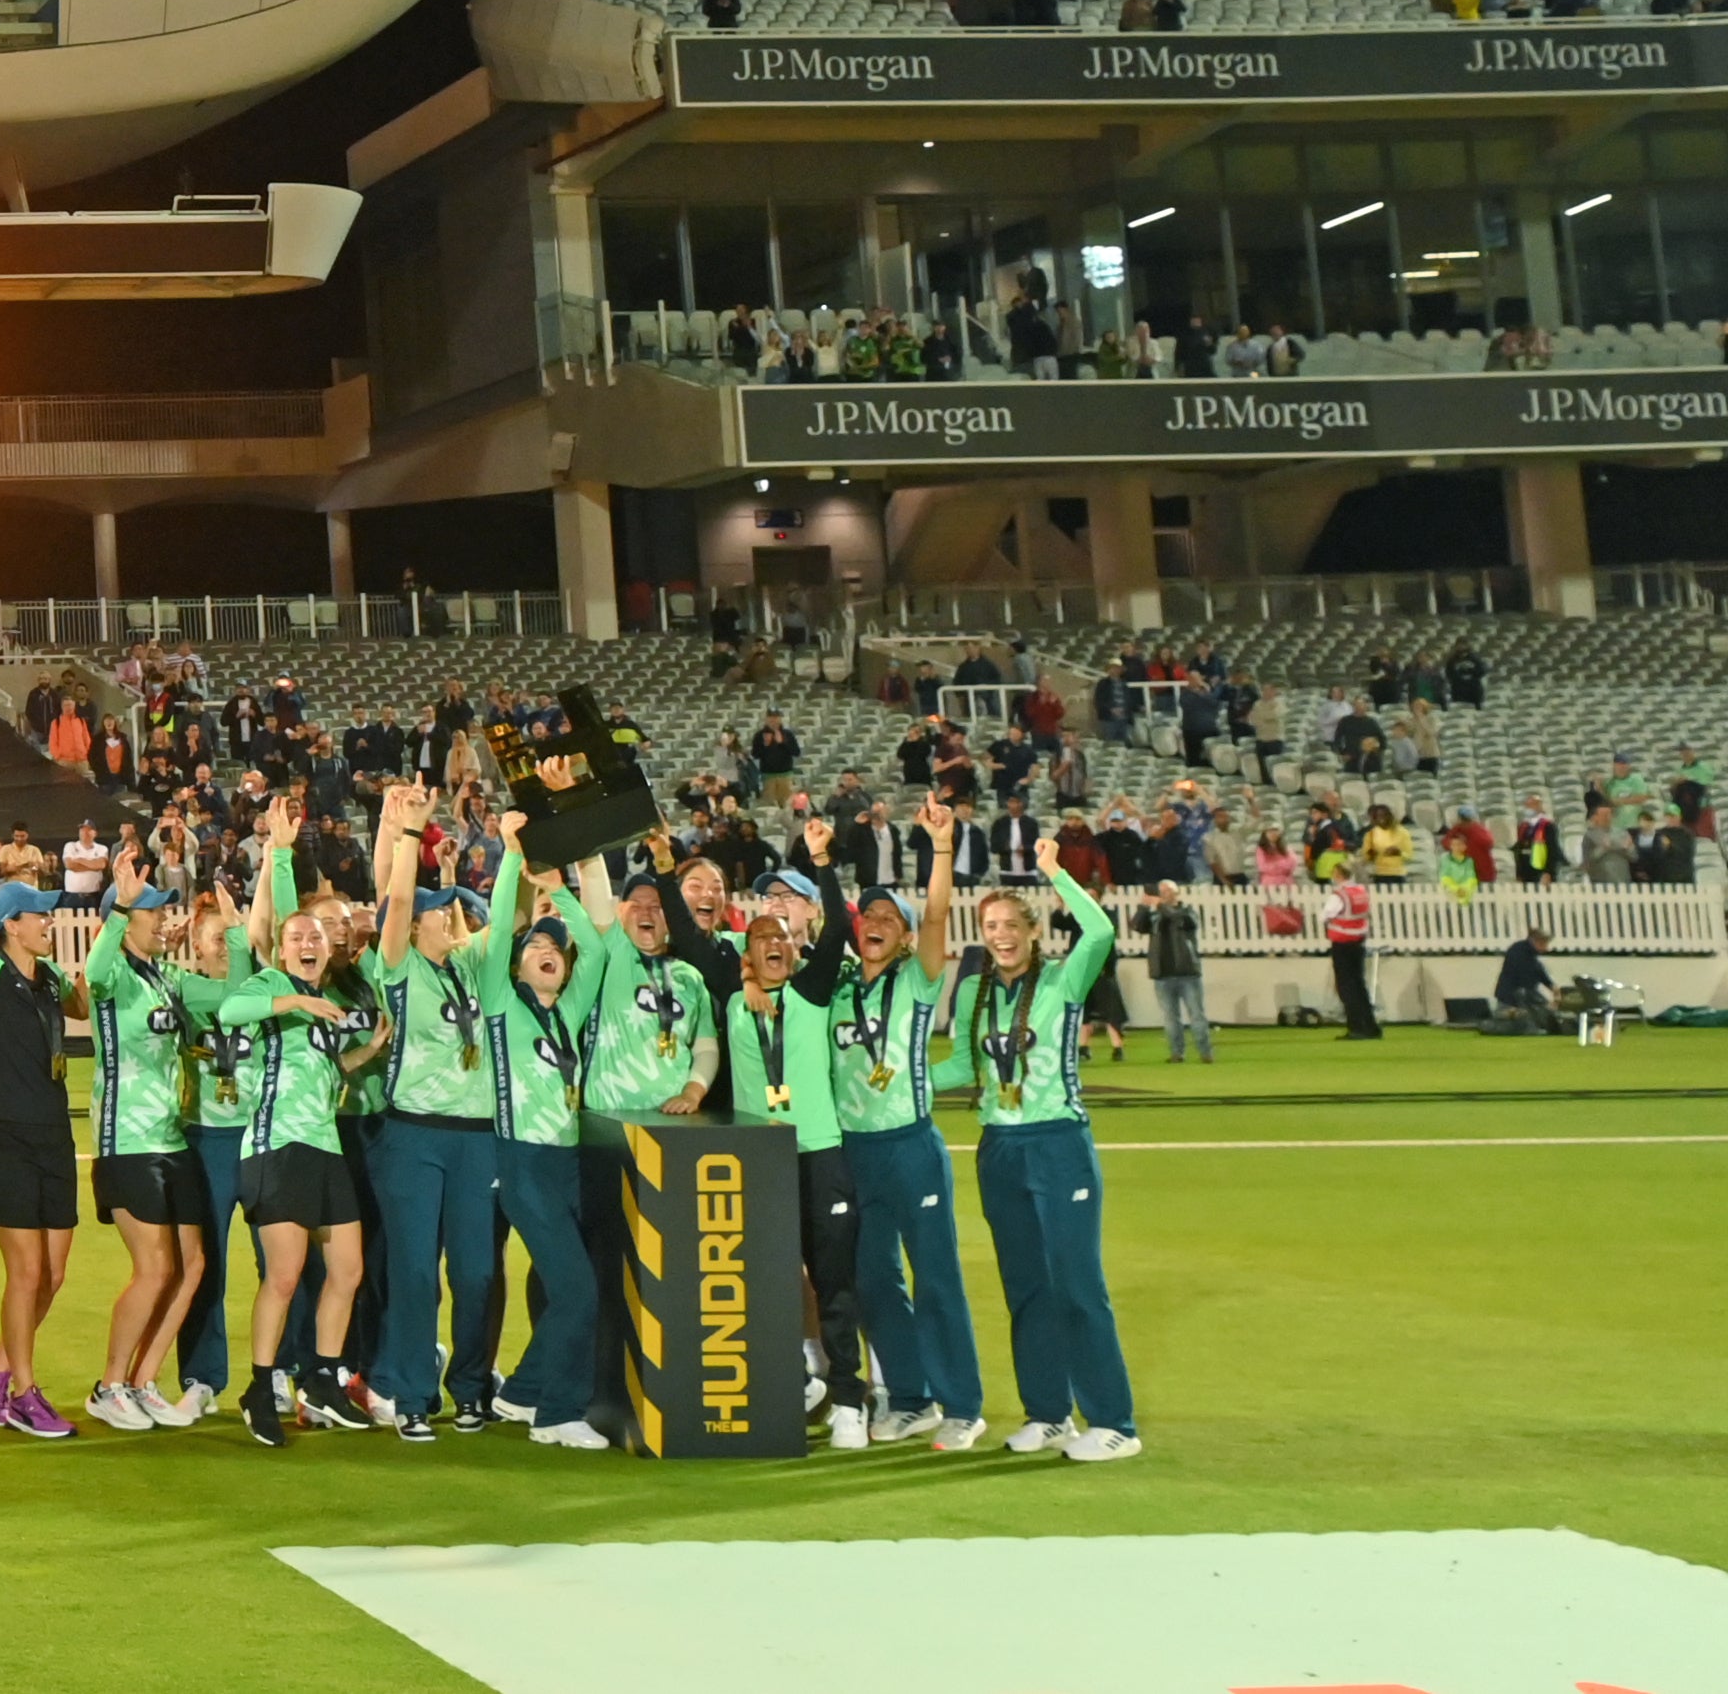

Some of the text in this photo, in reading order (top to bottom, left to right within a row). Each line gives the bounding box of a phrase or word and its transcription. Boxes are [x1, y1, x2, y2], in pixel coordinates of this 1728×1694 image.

[733, 48, 935, 92] J.P.Morgan
[1082, 46, 1280, 89] J.P.Morgan
[1465, 38, 1669, 79] J.P.Morgan
[806, 400, 1014, 445] J.P.Morgan
[1165, 396, 1369, 440] J.P.Morgan
[1520, 387, 1728, 431] J.P.Morgan
[696, 1154, 749, 1433] HUNDRED
